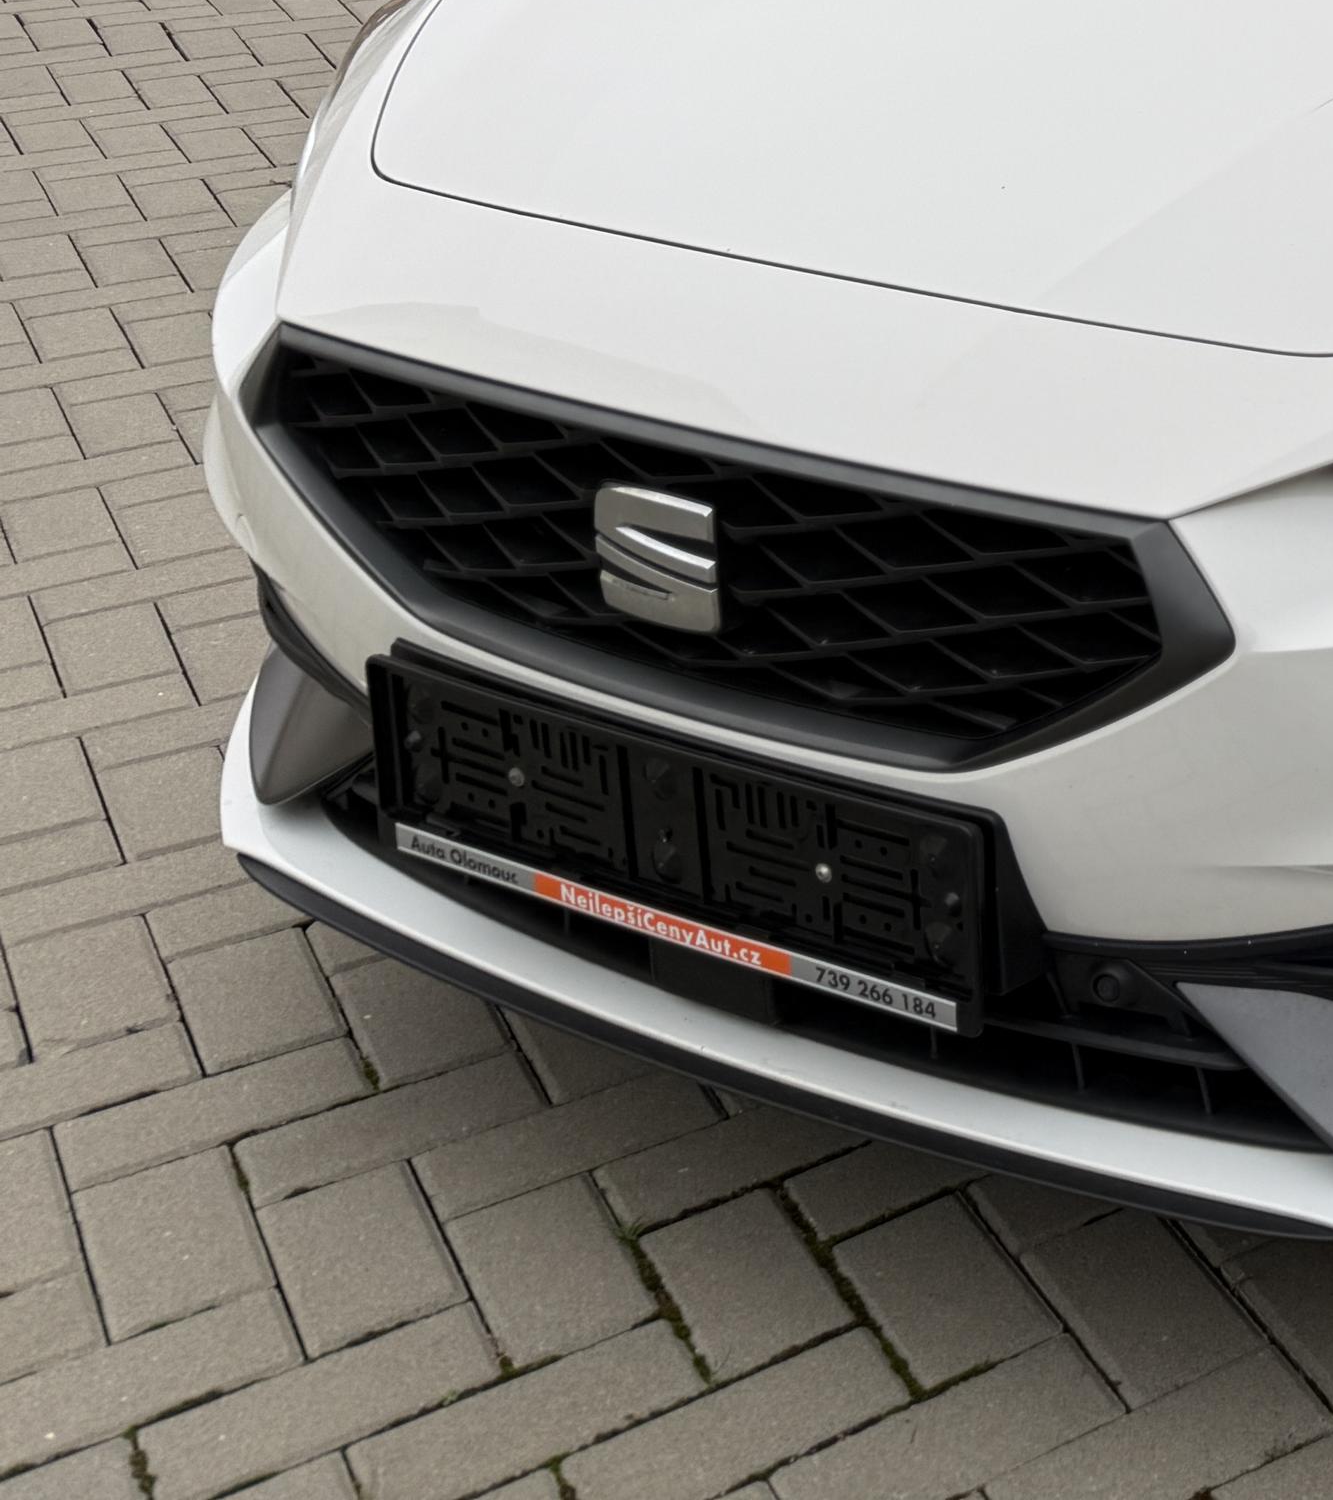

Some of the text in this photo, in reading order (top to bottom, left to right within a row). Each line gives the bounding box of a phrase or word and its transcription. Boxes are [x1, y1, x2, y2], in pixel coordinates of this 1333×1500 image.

[815, 966, 937, 1019] 739 266 184
